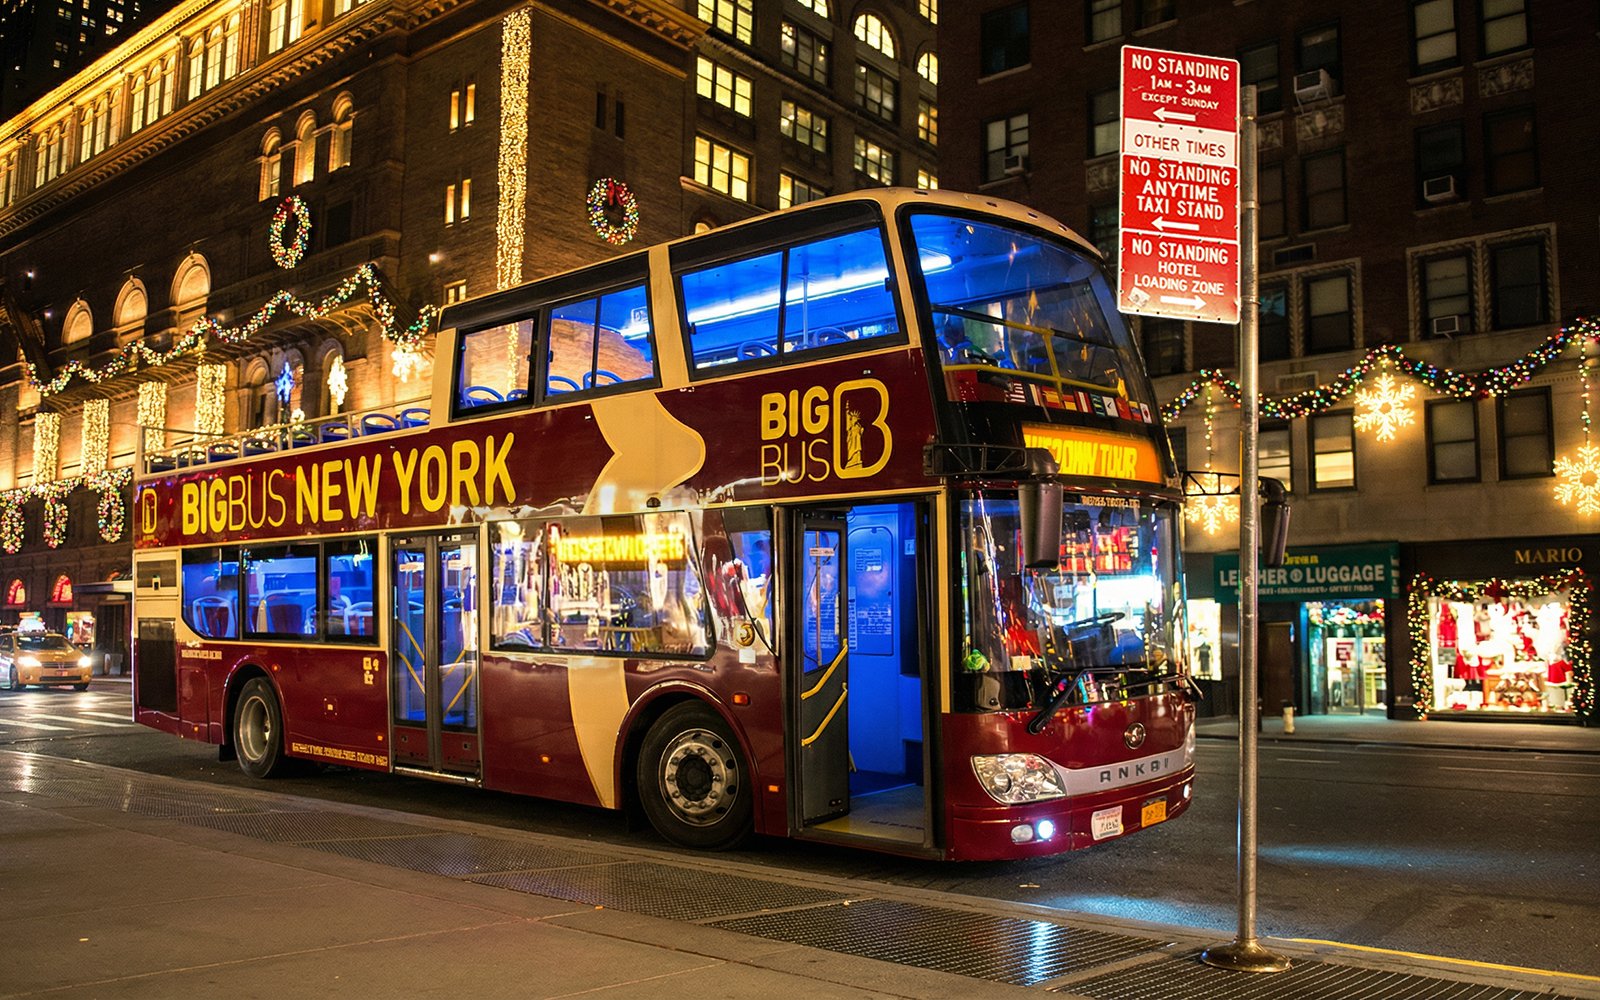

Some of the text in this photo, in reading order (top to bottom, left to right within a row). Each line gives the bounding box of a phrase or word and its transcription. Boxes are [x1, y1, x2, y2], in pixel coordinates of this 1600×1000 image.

[1132, 54, 1230, 81] NO STANDING
[1150, 75, 1172, 90] 1AM
[1185, 79, 1212, 95] 3AM
[1141, 92, 1219, 110] EXCEPT SUNDAY
[1134, 133, 1226, 158] OTHER TIMES
[1130, 159, 1230, 186] NO STANDING
[1142, 179, 1219, 203] ANYTIME
[1136, 195, 1224, 220] TAXI STAND
[1132, 238, 1229, 265] NO STANDING
[1158, 260, 1202, 278] HOTEL
[1134, 274, 1225, 296] LOADING ZONE
[761, 386, 830, 440] BIG
[761, 438, 831, 487] BUS
[296, 454, 382, 525] NEW
[392, 432, 516, 514] YORK
[1515, 548, 1583, 564] MARIO
[1219, 569, 1288, 586] LEHER
[1306, 564, 1385, 583] LUGGAGE
